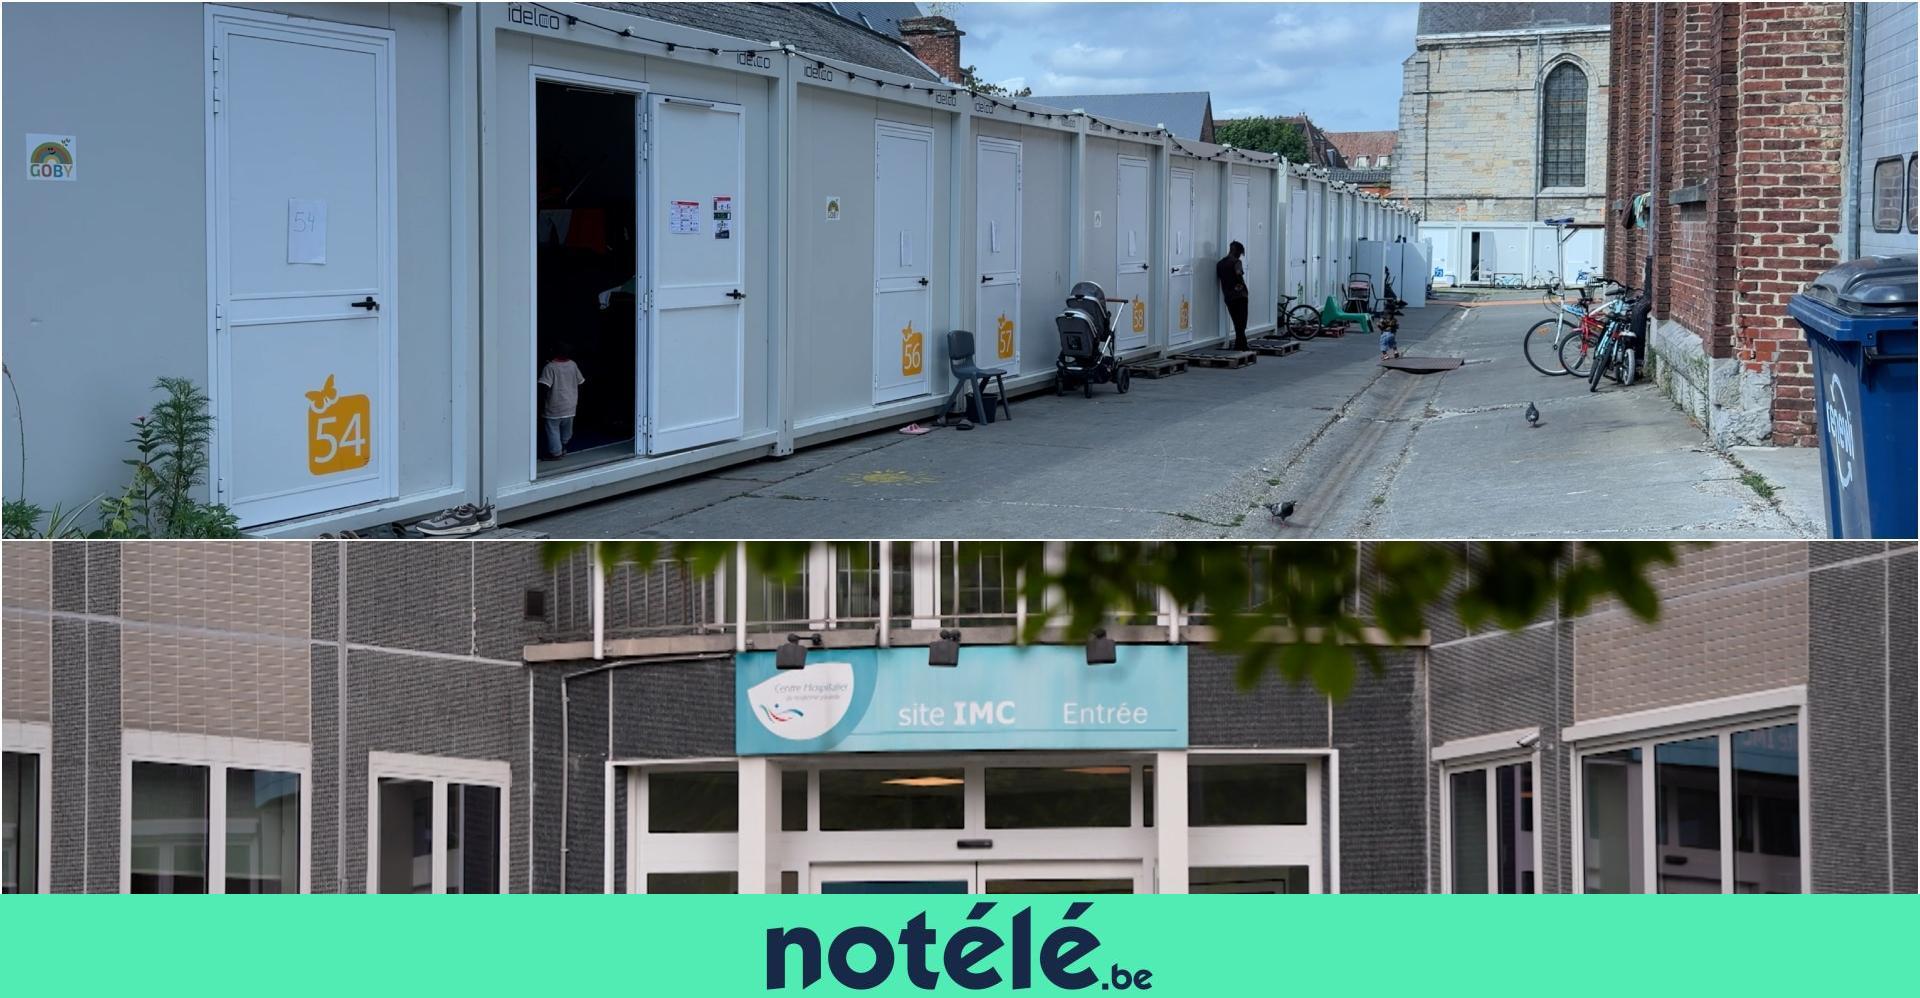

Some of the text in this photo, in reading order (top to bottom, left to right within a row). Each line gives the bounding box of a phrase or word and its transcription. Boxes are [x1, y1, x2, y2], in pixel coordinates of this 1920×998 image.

[508, 2, 560, 30] idelco
[30, 164, 73, 178] GOBY
[292, 211, 315, 232] 54
[1000, 329, 1013, 353] 57
[904, 343, 921, 370] 56
[314, 412, 366, 463] 54
[898, 701, 1148, 726] site IMC Entrée
